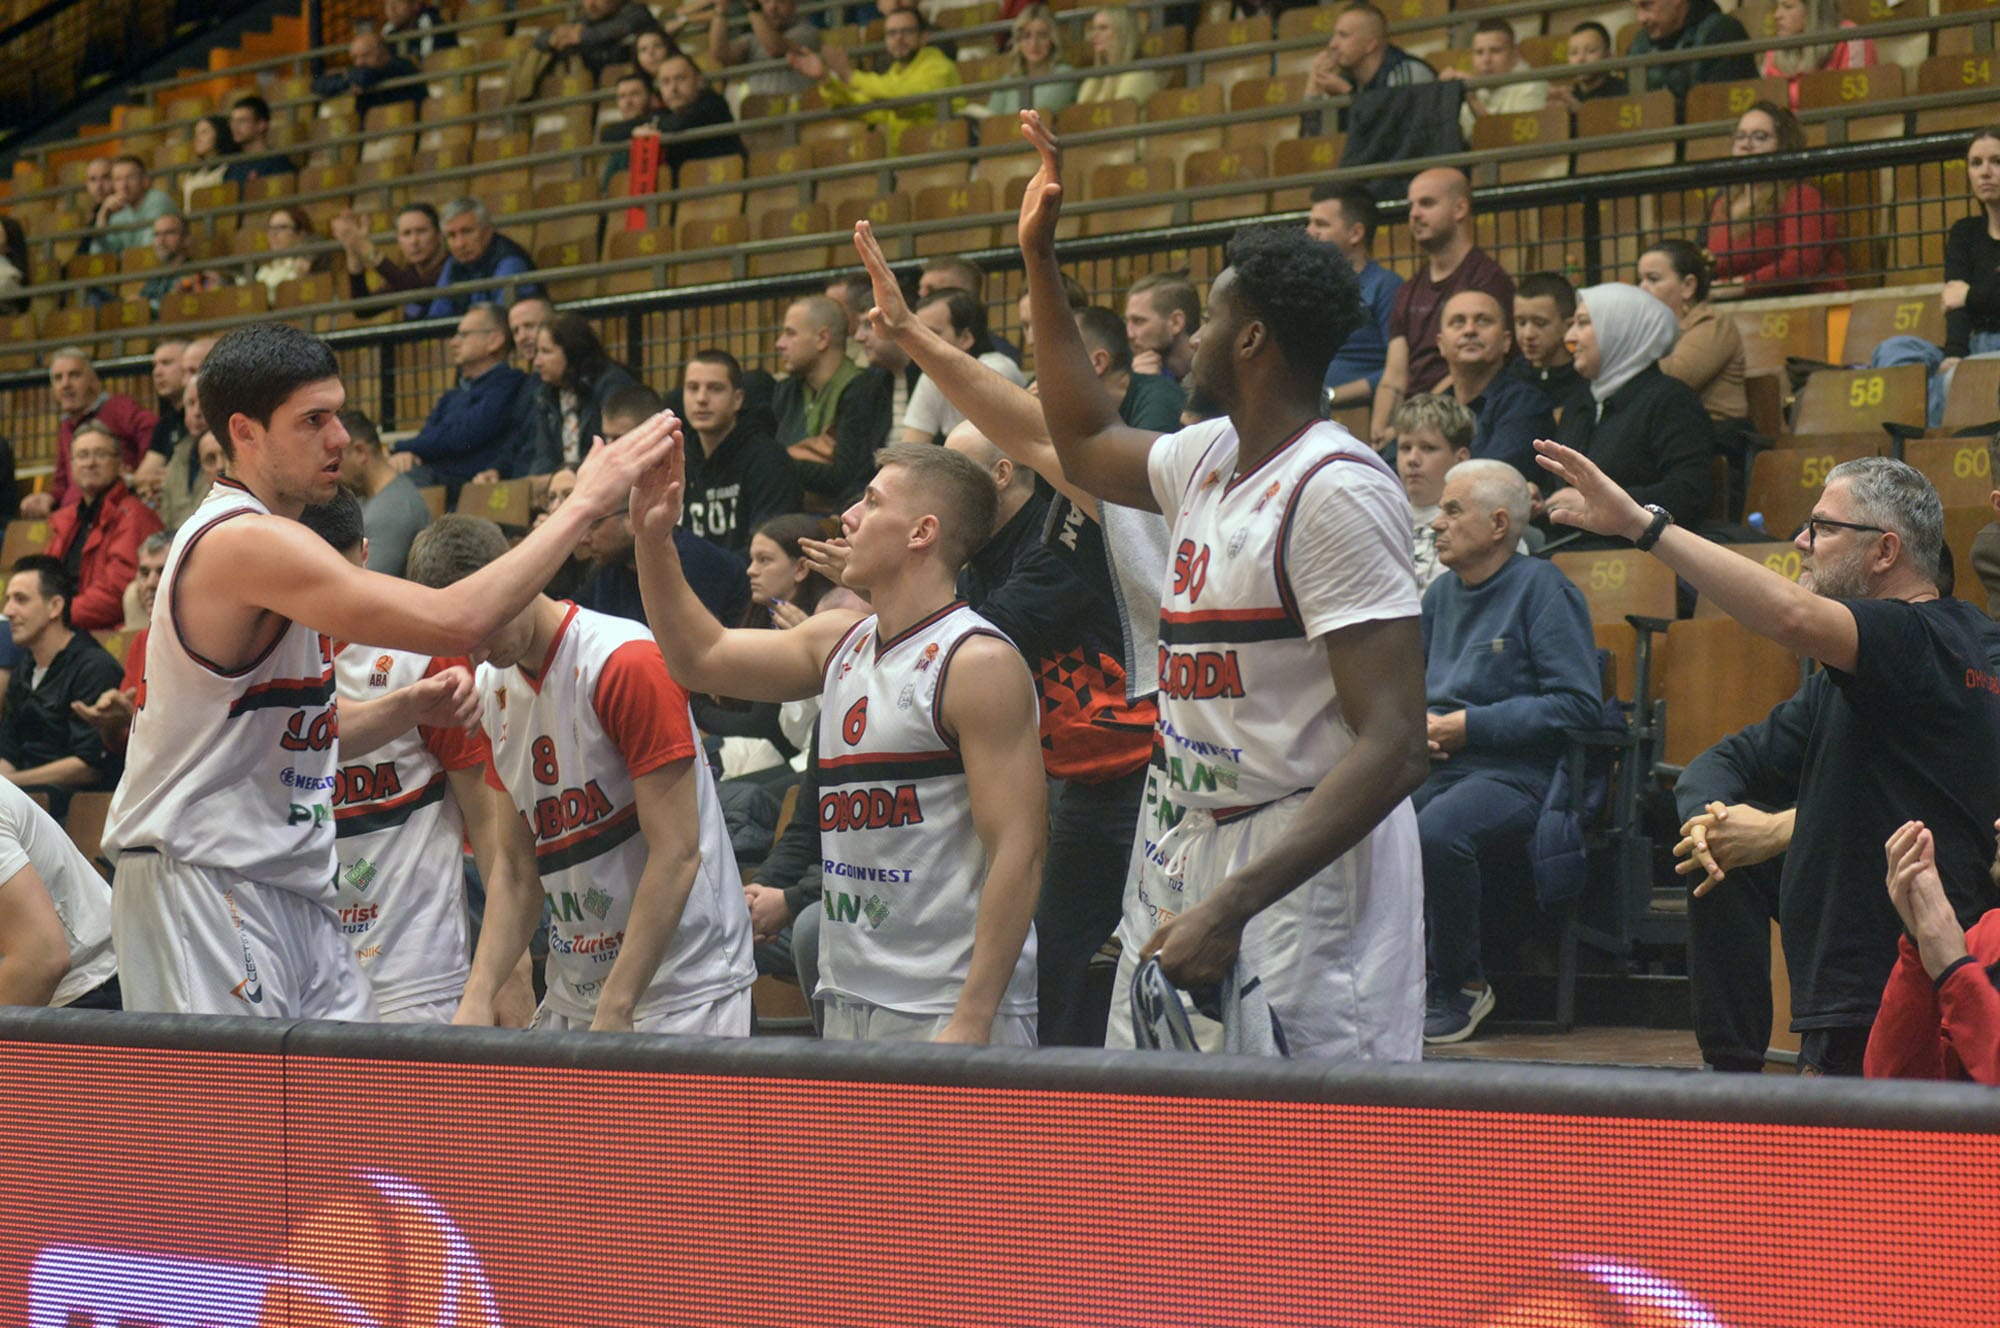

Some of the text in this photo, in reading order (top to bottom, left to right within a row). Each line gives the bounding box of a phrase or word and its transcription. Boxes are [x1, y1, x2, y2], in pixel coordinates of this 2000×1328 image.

[1841, 74, 1869, 100] 53
[1961, 60, 1990, 86] 54
[1512, 118, 1539, 141] 50
[1619, 104, 1643, 129] 51
[1760, 312, 1790, 340] 56
[1893, 302, 1925, 331] 57
[1850, 376, 1886, 408] 58
[1801, 453, 1836, 488] 59
[1953, 448, 1991, 479] 60
[1590, 558, 1627, 592] 59
[1764, 551, 1801, 582] 60
[369, 673, 388, 687] ABA
[842, 695, 869, 747] 6
[531, 735, 559, 786] 8
